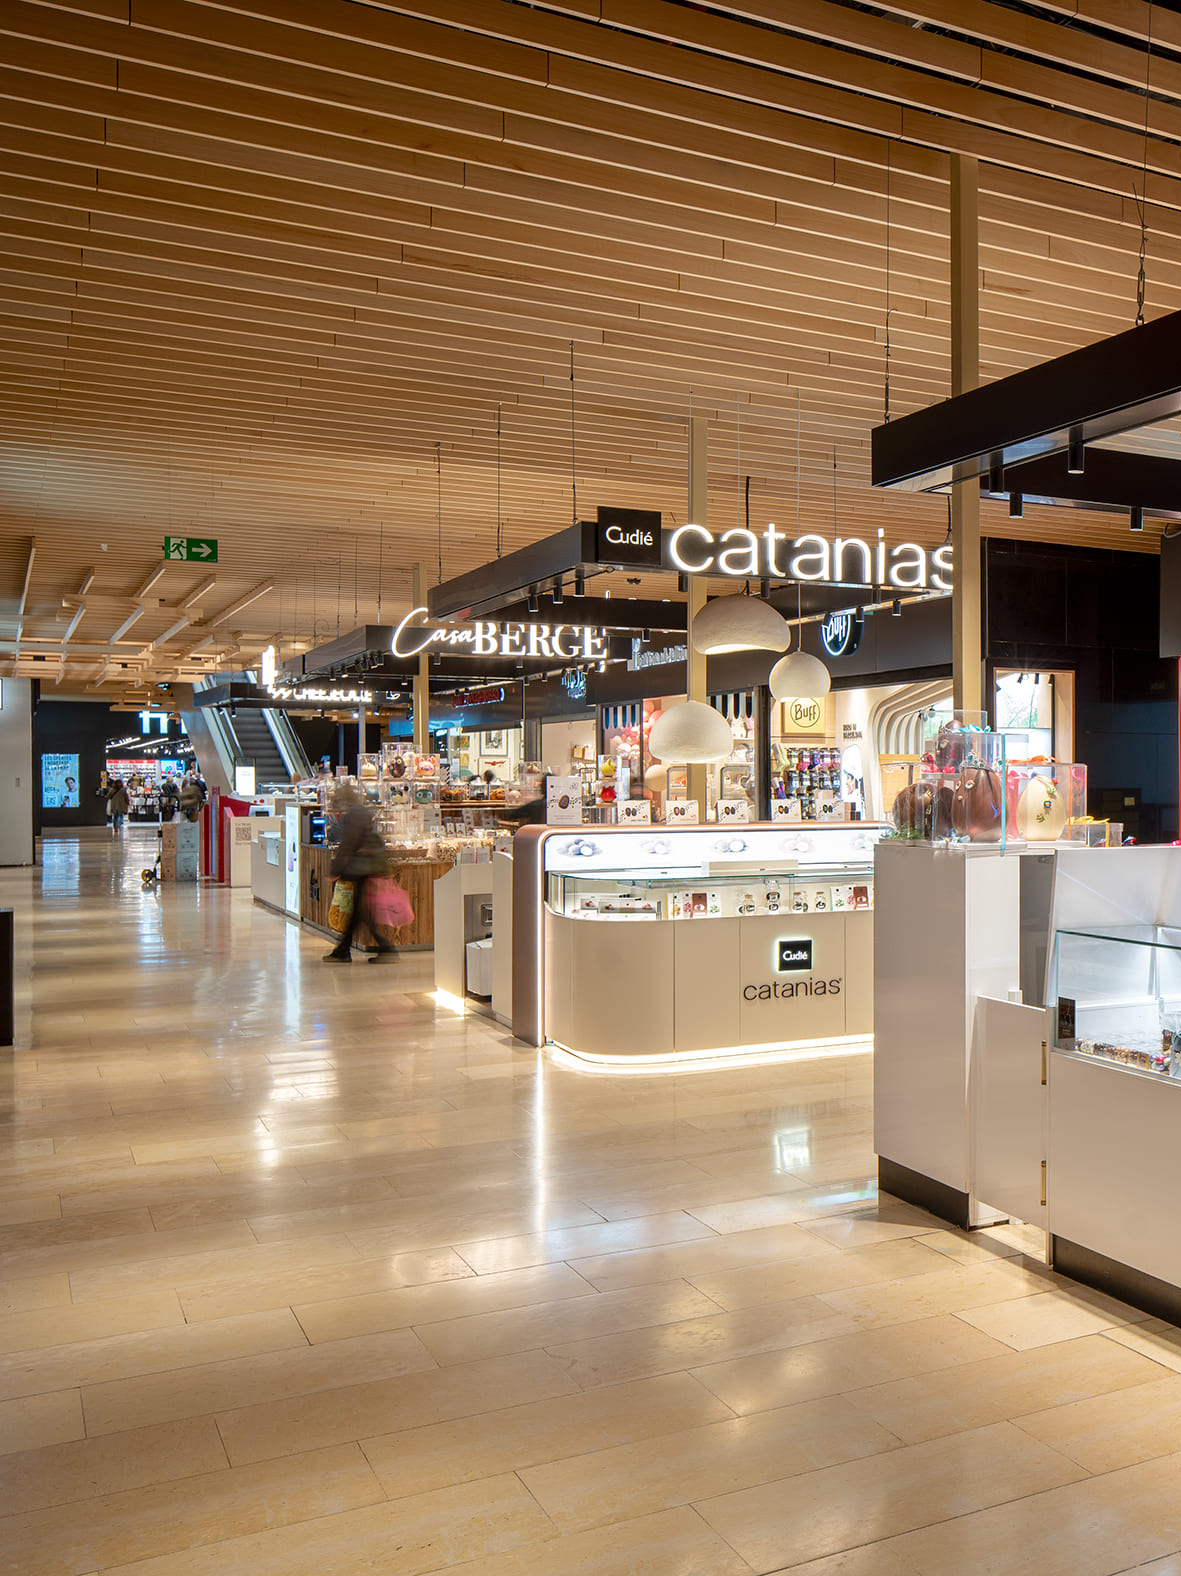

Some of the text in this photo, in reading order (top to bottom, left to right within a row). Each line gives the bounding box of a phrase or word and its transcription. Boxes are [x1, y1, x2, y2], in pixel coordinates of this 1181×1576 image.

[605, 526, 653, 546] Cudié
[390, 607, 476, 658] Casa
[471, 621, 607, 658] BERGE
[782, 951, 808, 961] Cudié
